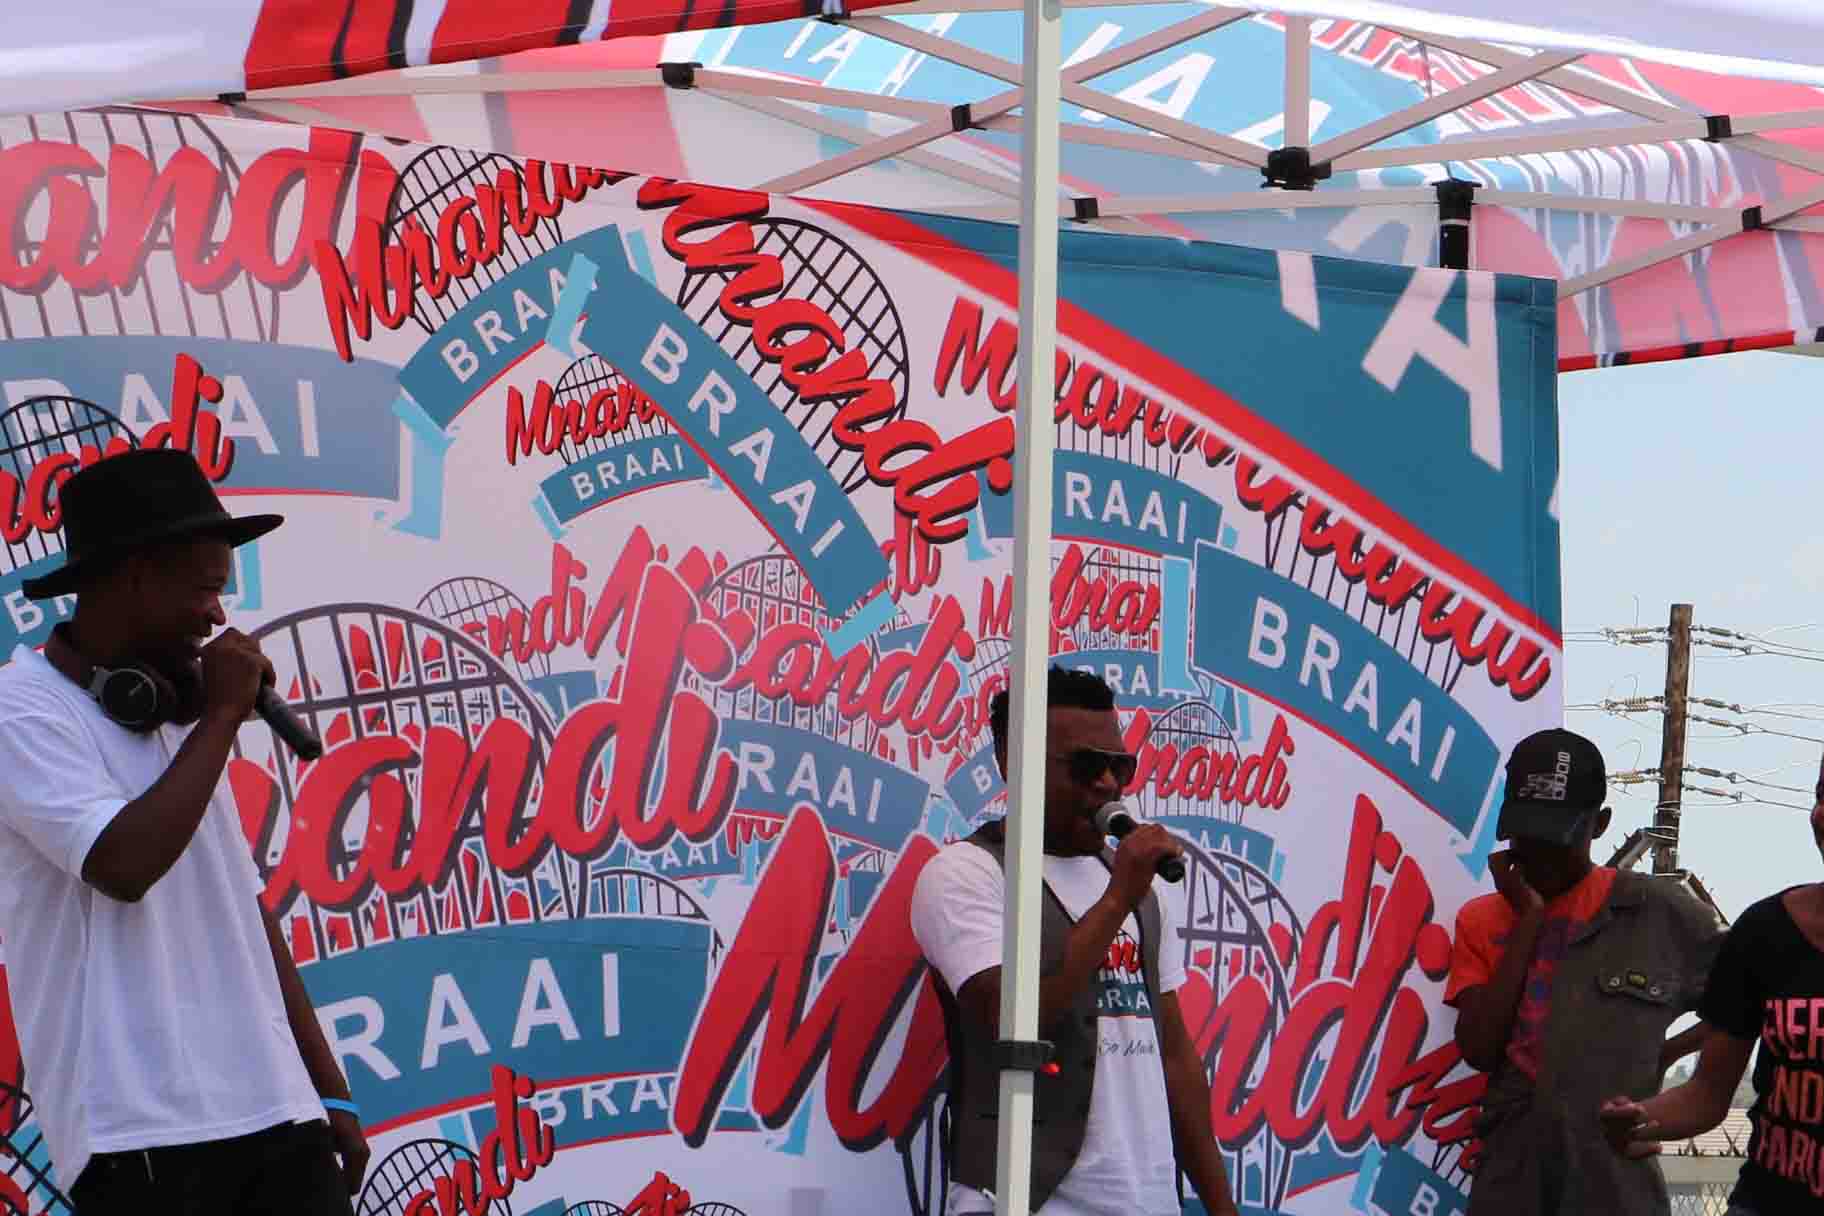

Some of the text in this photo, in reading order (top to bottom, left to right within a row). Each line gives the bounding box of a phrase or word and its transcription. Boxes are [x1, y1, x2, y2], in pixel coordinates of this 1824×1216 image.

[570, 443, 686, 502] BRAAI
[641, 322, 846, 558] BRAAI
[1064, 471, 1189, 546] RAAI
[1247, 596, 1456, 783] BRAAI
[738, 741, 883, 824] RAAI
[318, 952, 622, 1083] RAAI
